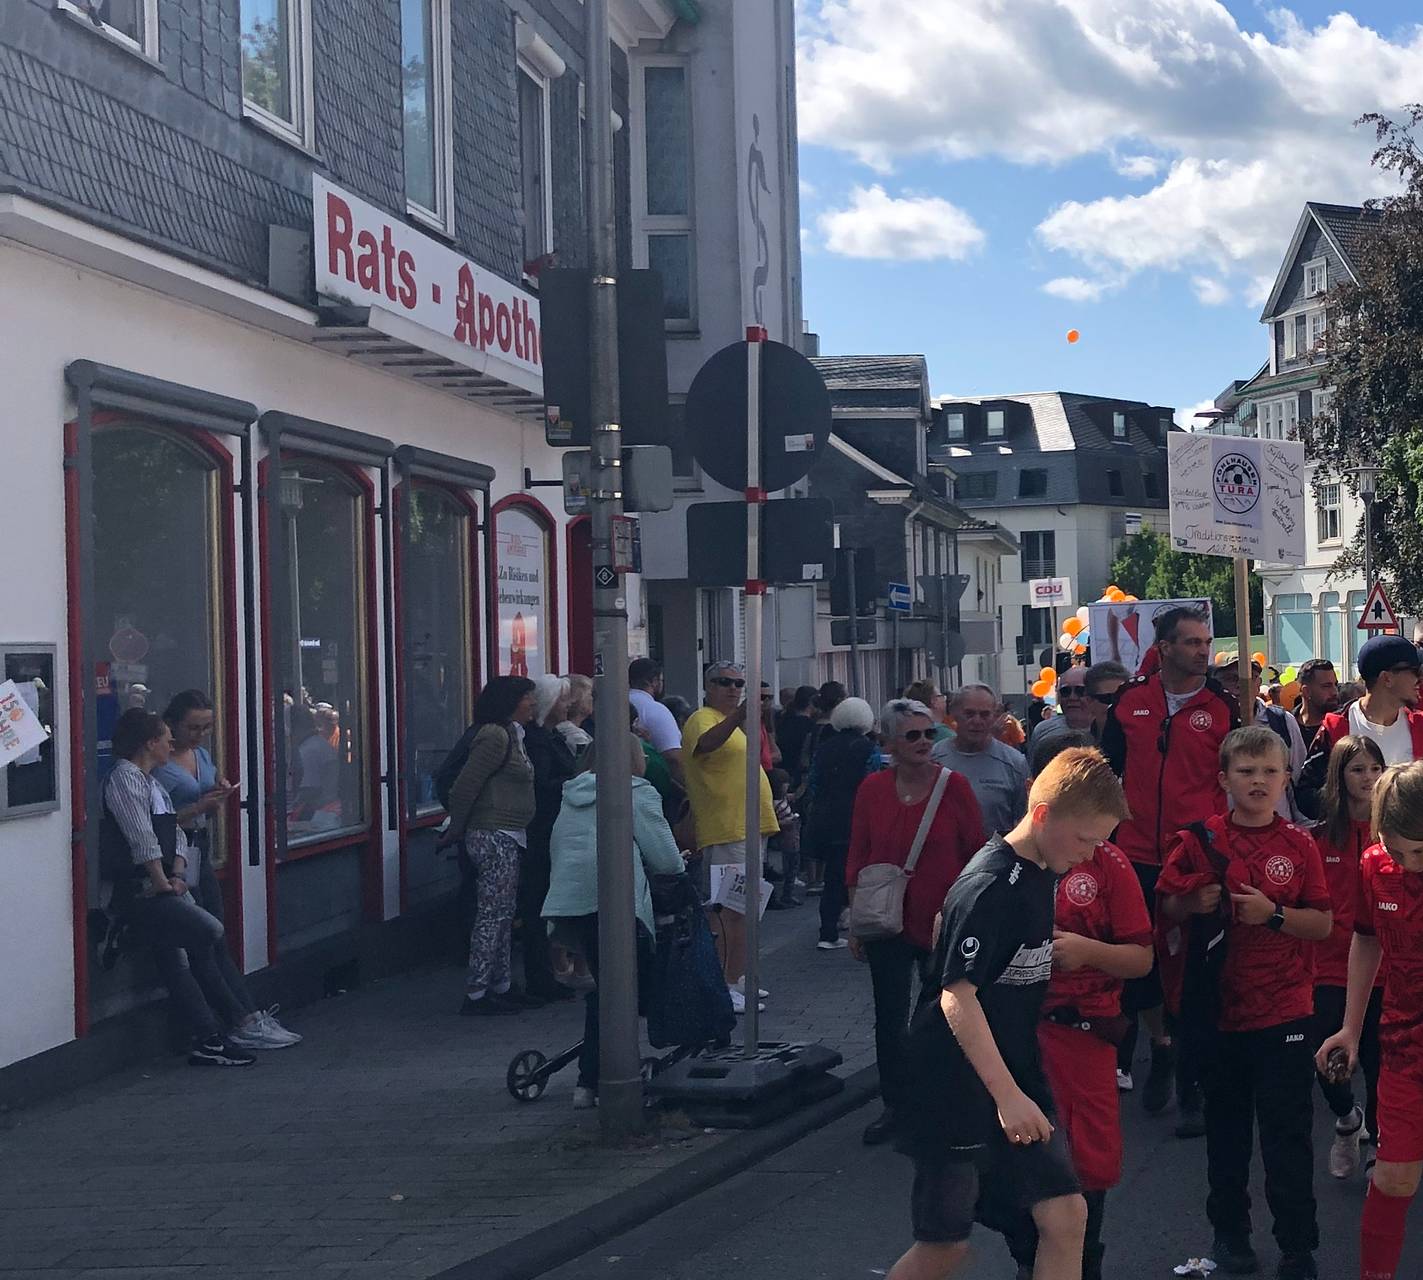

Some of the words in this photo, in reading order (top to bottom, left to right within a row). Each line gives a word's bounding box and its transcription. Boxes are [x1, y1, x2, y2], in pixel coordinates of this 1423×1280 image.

[327, 191, 417, 310] Rats
[454, 262, 543, 365] Apoth
[1220, 485, 1254, 496] TURA
[1035, 584, 1062, 595] CDU
[1133, 709, 1150, 717] JAKO
[1378, 901, 1399, 912] JAKO
[1286, 1033, 1304, 1043] JAKO
